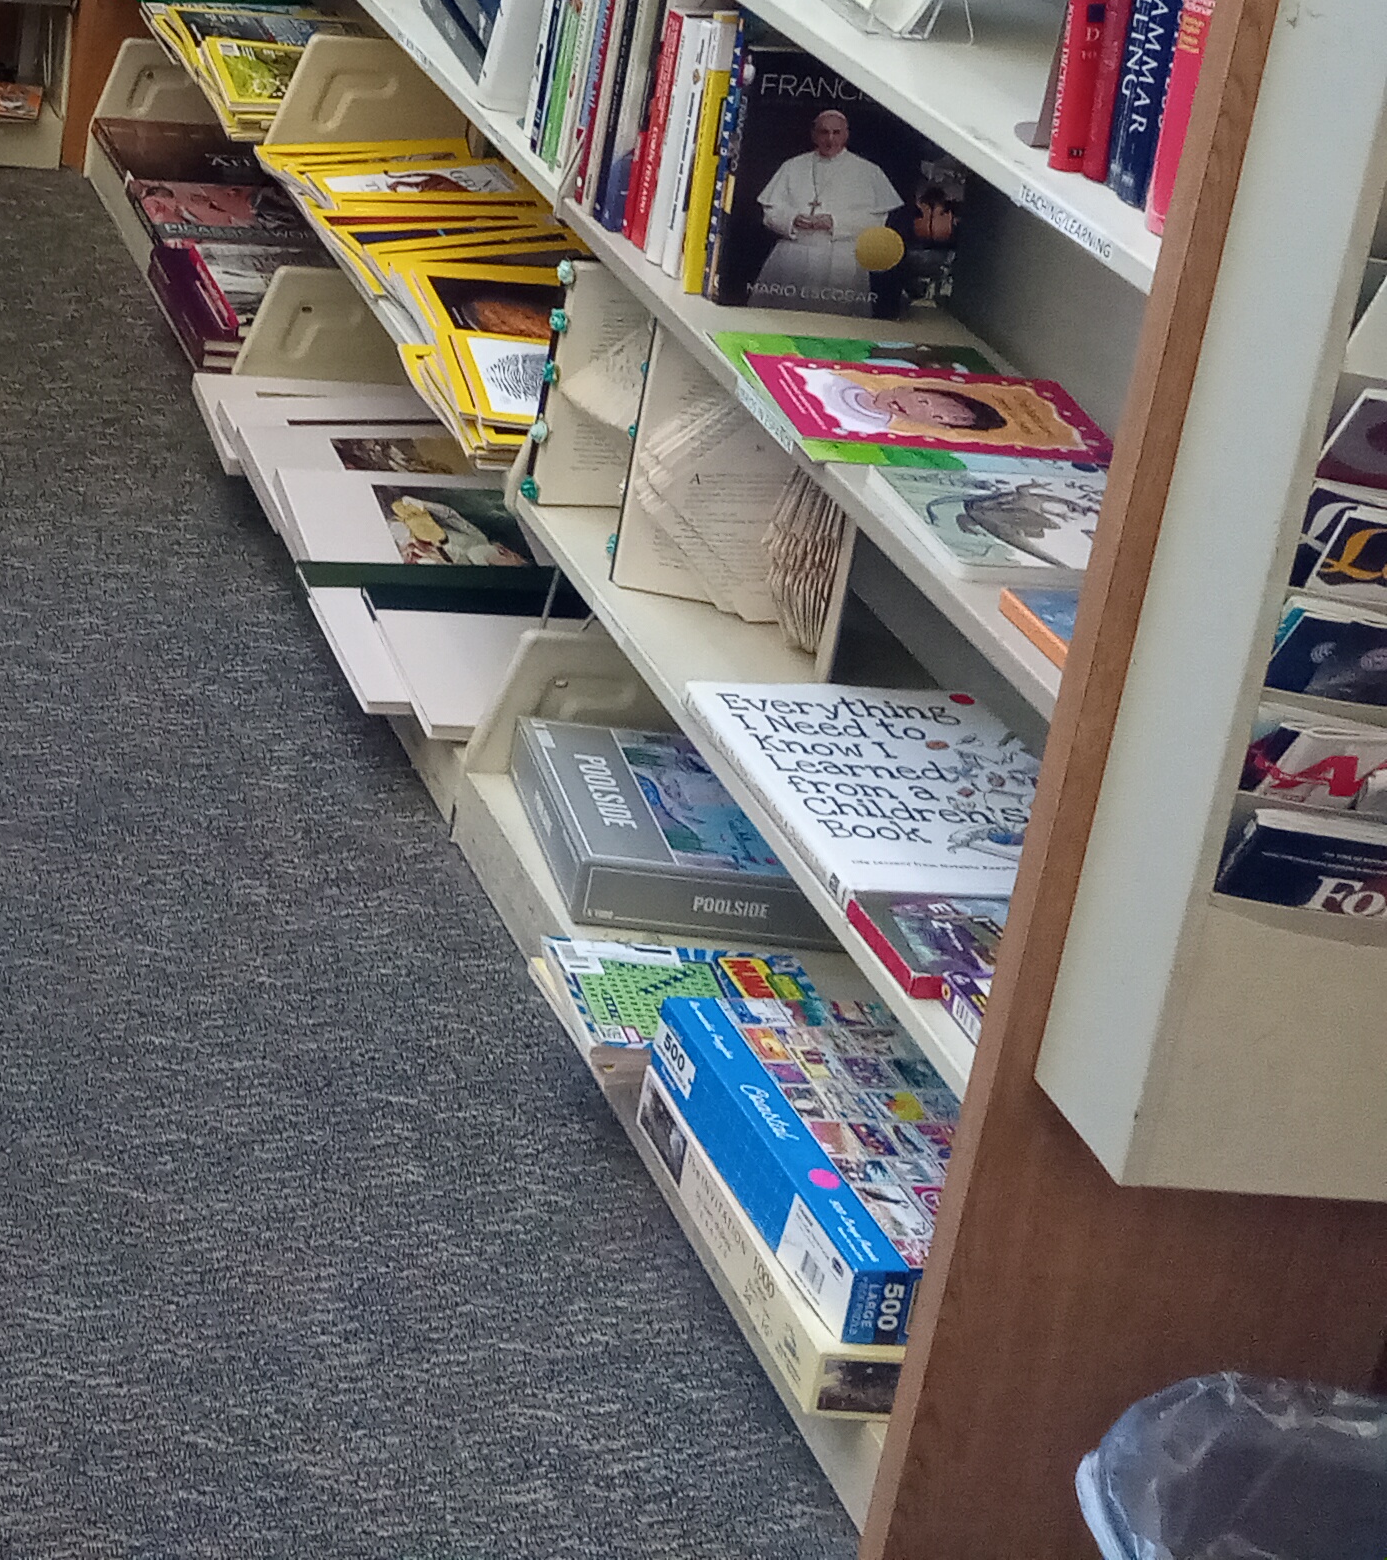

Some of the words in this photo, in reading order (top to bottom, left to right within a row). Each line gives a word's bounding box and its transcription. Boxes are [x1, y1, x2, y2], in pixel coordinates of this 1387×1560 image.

[1018, 184, 1113, 261] TEACHING/LEARNING
[746, 280, 797, 299] MARIO
[716, 692, 961, 726] Everything
[731, 713, 757, 732] I
[764, 714, 871, 740] Need
[876, 719, 927, 742] to
[749, 732, 865, 759] Know
[873, 741, 899, 760] I
[764, 753, 951, 783] Learned
[573, 752, 639, 831] POOLSIDE
[786, 774, 901, 801] from
[908, 783, 940, 802] a
[803, 796, 1030, 826] Children's
[816, 817, 933, 845] Book
[692, 895, 771, 920] POOLSIDE
[662, 1033, 687, 1075] 500
[860, 1281, 884, 1329] LARGE
[876, 1281, 907, 1332] 500
